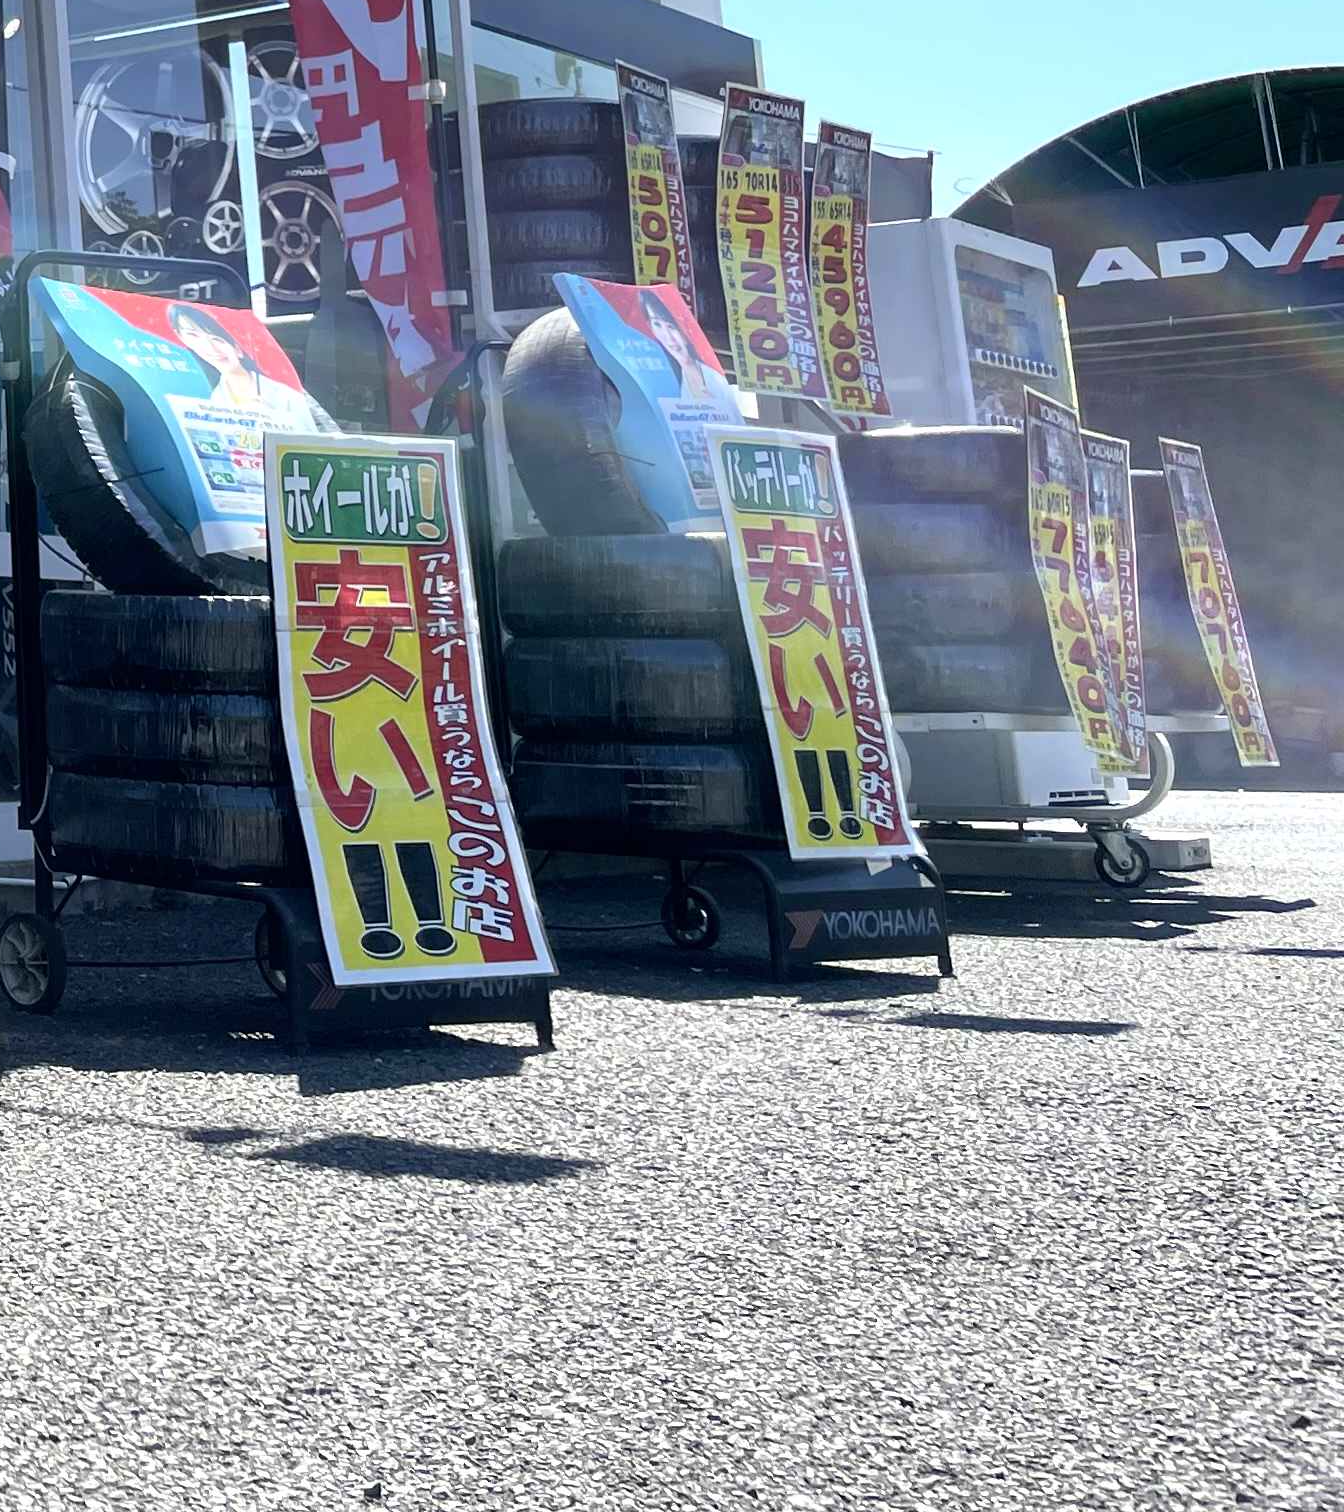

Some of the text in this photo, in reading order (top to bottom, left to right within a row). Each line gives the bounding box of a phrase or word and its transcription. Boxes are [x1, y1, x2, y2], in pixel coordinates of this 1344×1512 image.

[747, 97, 801, 121] YOKOHAMA
[637, 174, 672, 286] 507
[734, 193, 794, 386] 51240円
[282, 459, 442, 540] ホイールが!
[294, 548, 457, 958] 安い!!
[418, 552, 516, 943] アルミホイール買うならこのお店
[740, 518, 863, 840] 安い!!
[822, 907, 942, 941] YOKOHAMA
